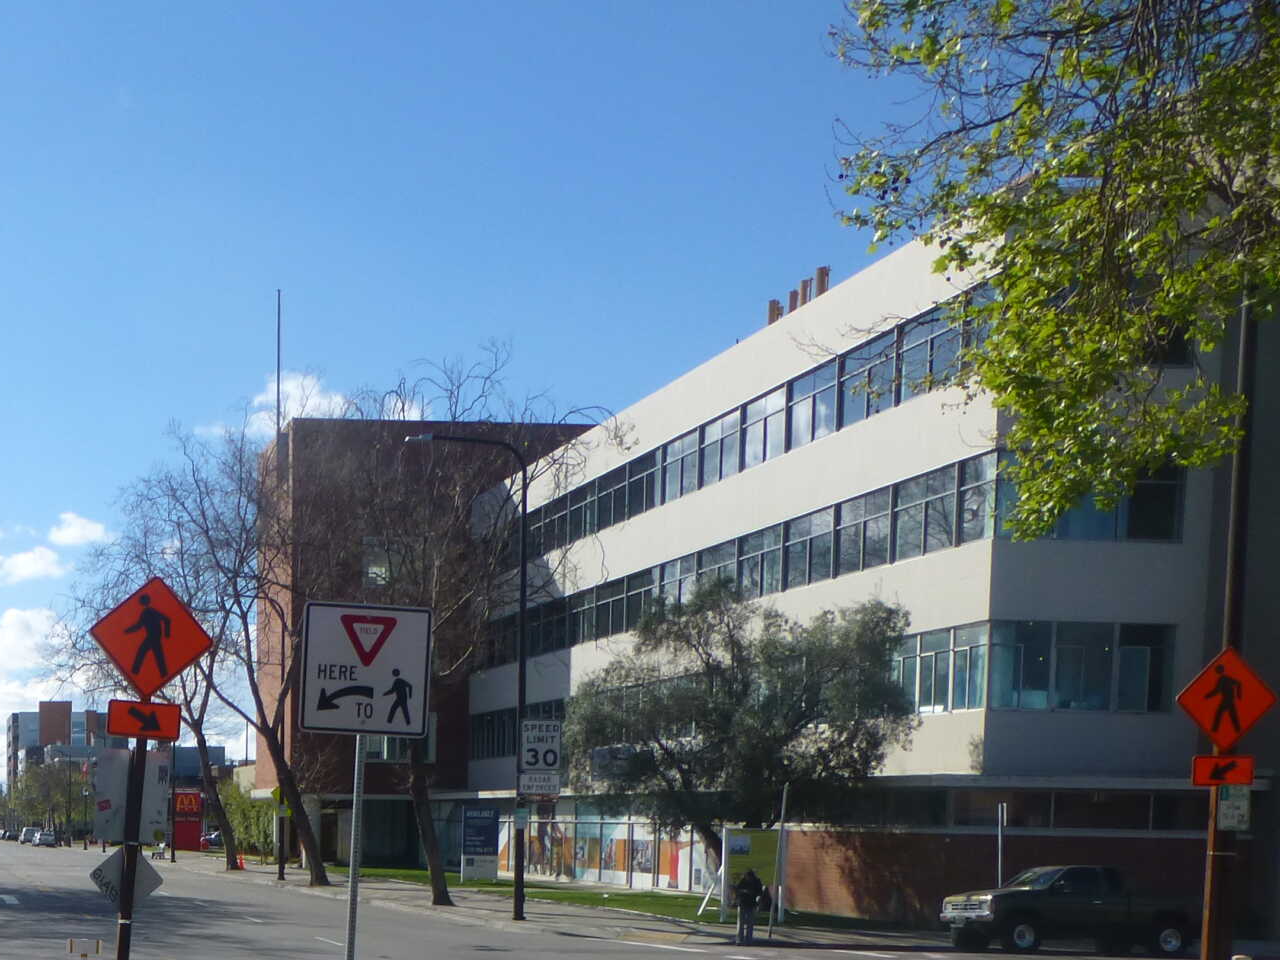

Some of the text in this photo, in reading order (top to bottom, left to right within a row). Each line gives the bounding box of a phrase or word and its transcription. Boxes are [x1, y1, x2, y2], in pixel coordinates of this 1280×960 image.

[359, 626, 379, 635] YIELD
[317, 664, 358, 681] HERE
[355, 702, 373, 719] TO
[523, 723, 560, 733] SPEED
[526, 735, 557, 744] LIMIT
[525, 748, 558, 767] 30
